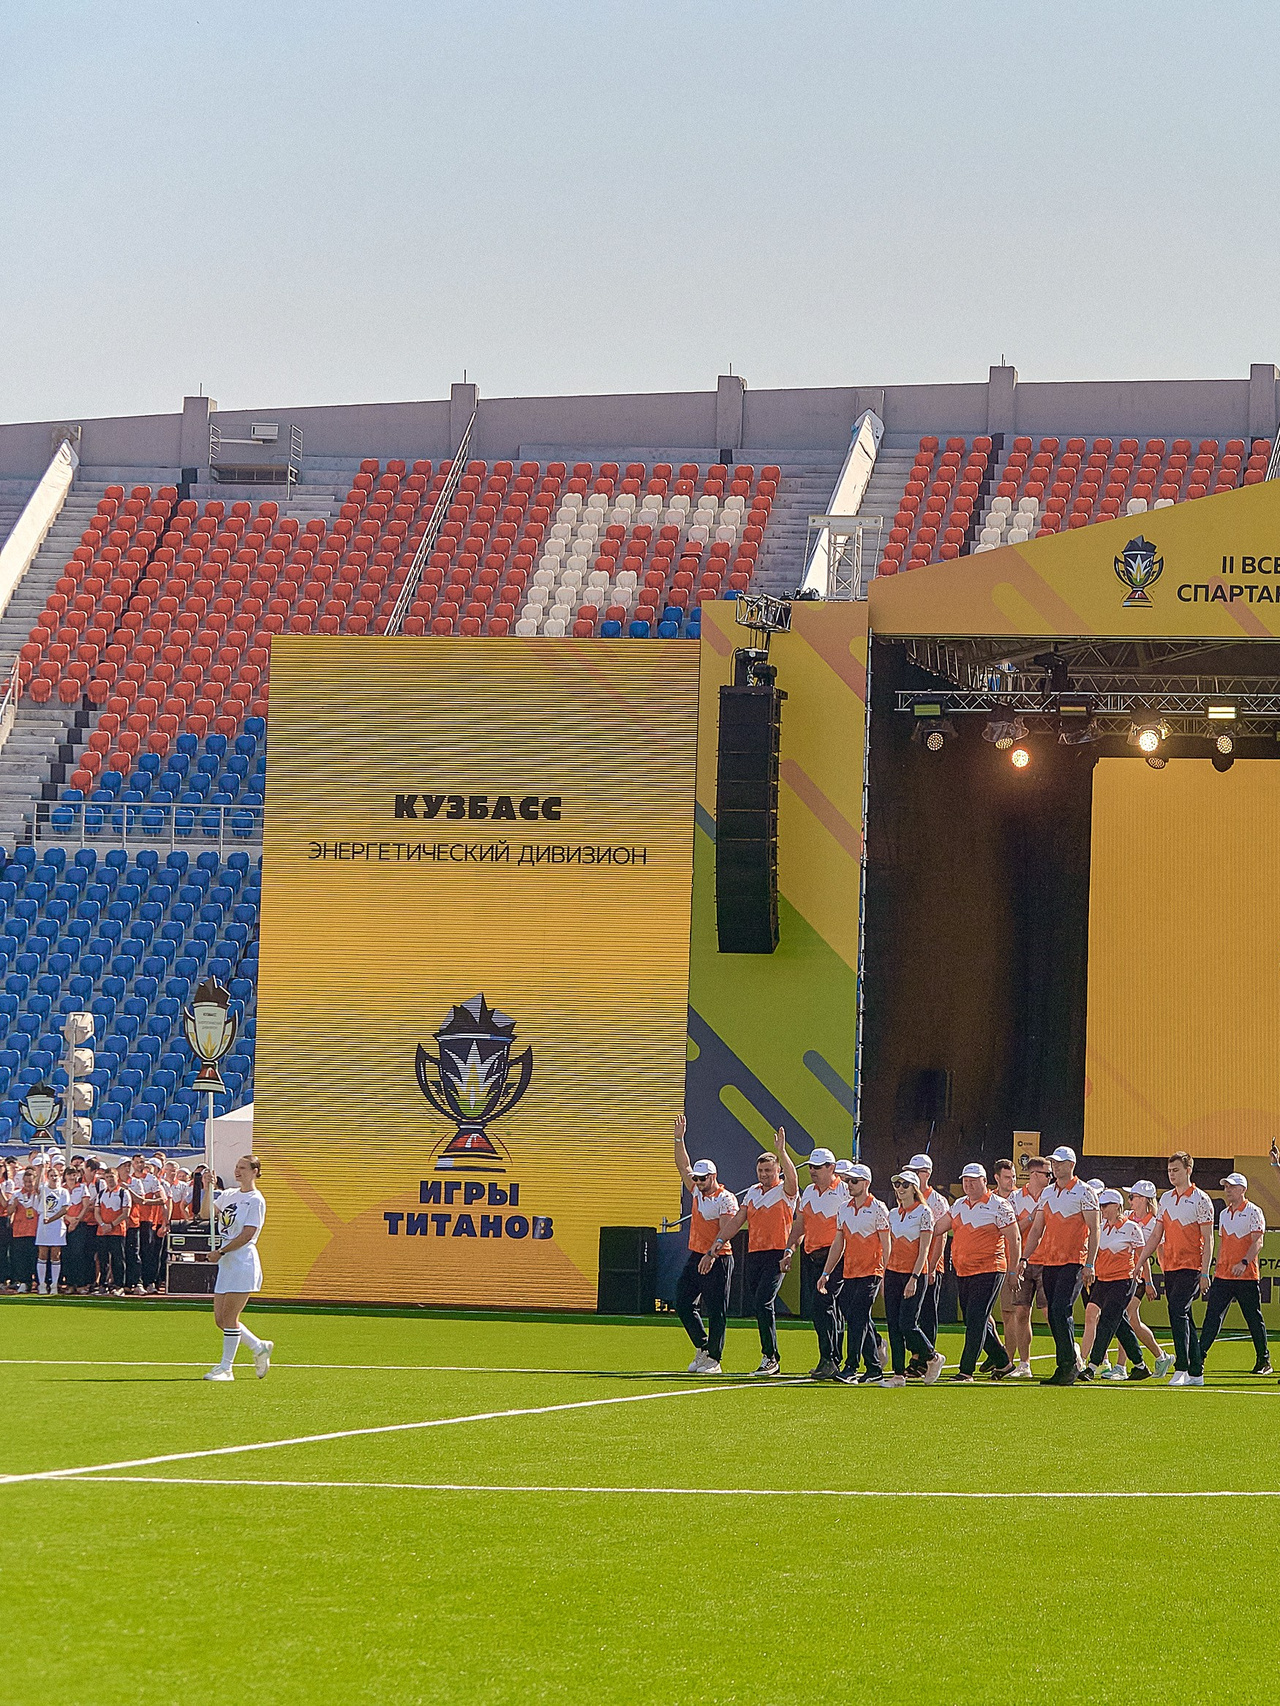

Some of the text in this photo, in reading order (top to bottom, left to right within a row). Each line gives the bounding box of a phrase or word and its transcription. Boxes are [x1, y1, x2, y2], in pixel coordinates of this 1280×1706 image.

[394, 794, 562, 821] КУЗБАСС
[308, 840, 647, 867] ЭНЕРГЕТИЧЕСКИЙ ДИВИЗИОН
[419, 1181, 520, 1207] ИГРЫ
[383, 1211, 555, 1240] ТИТАНОВ
